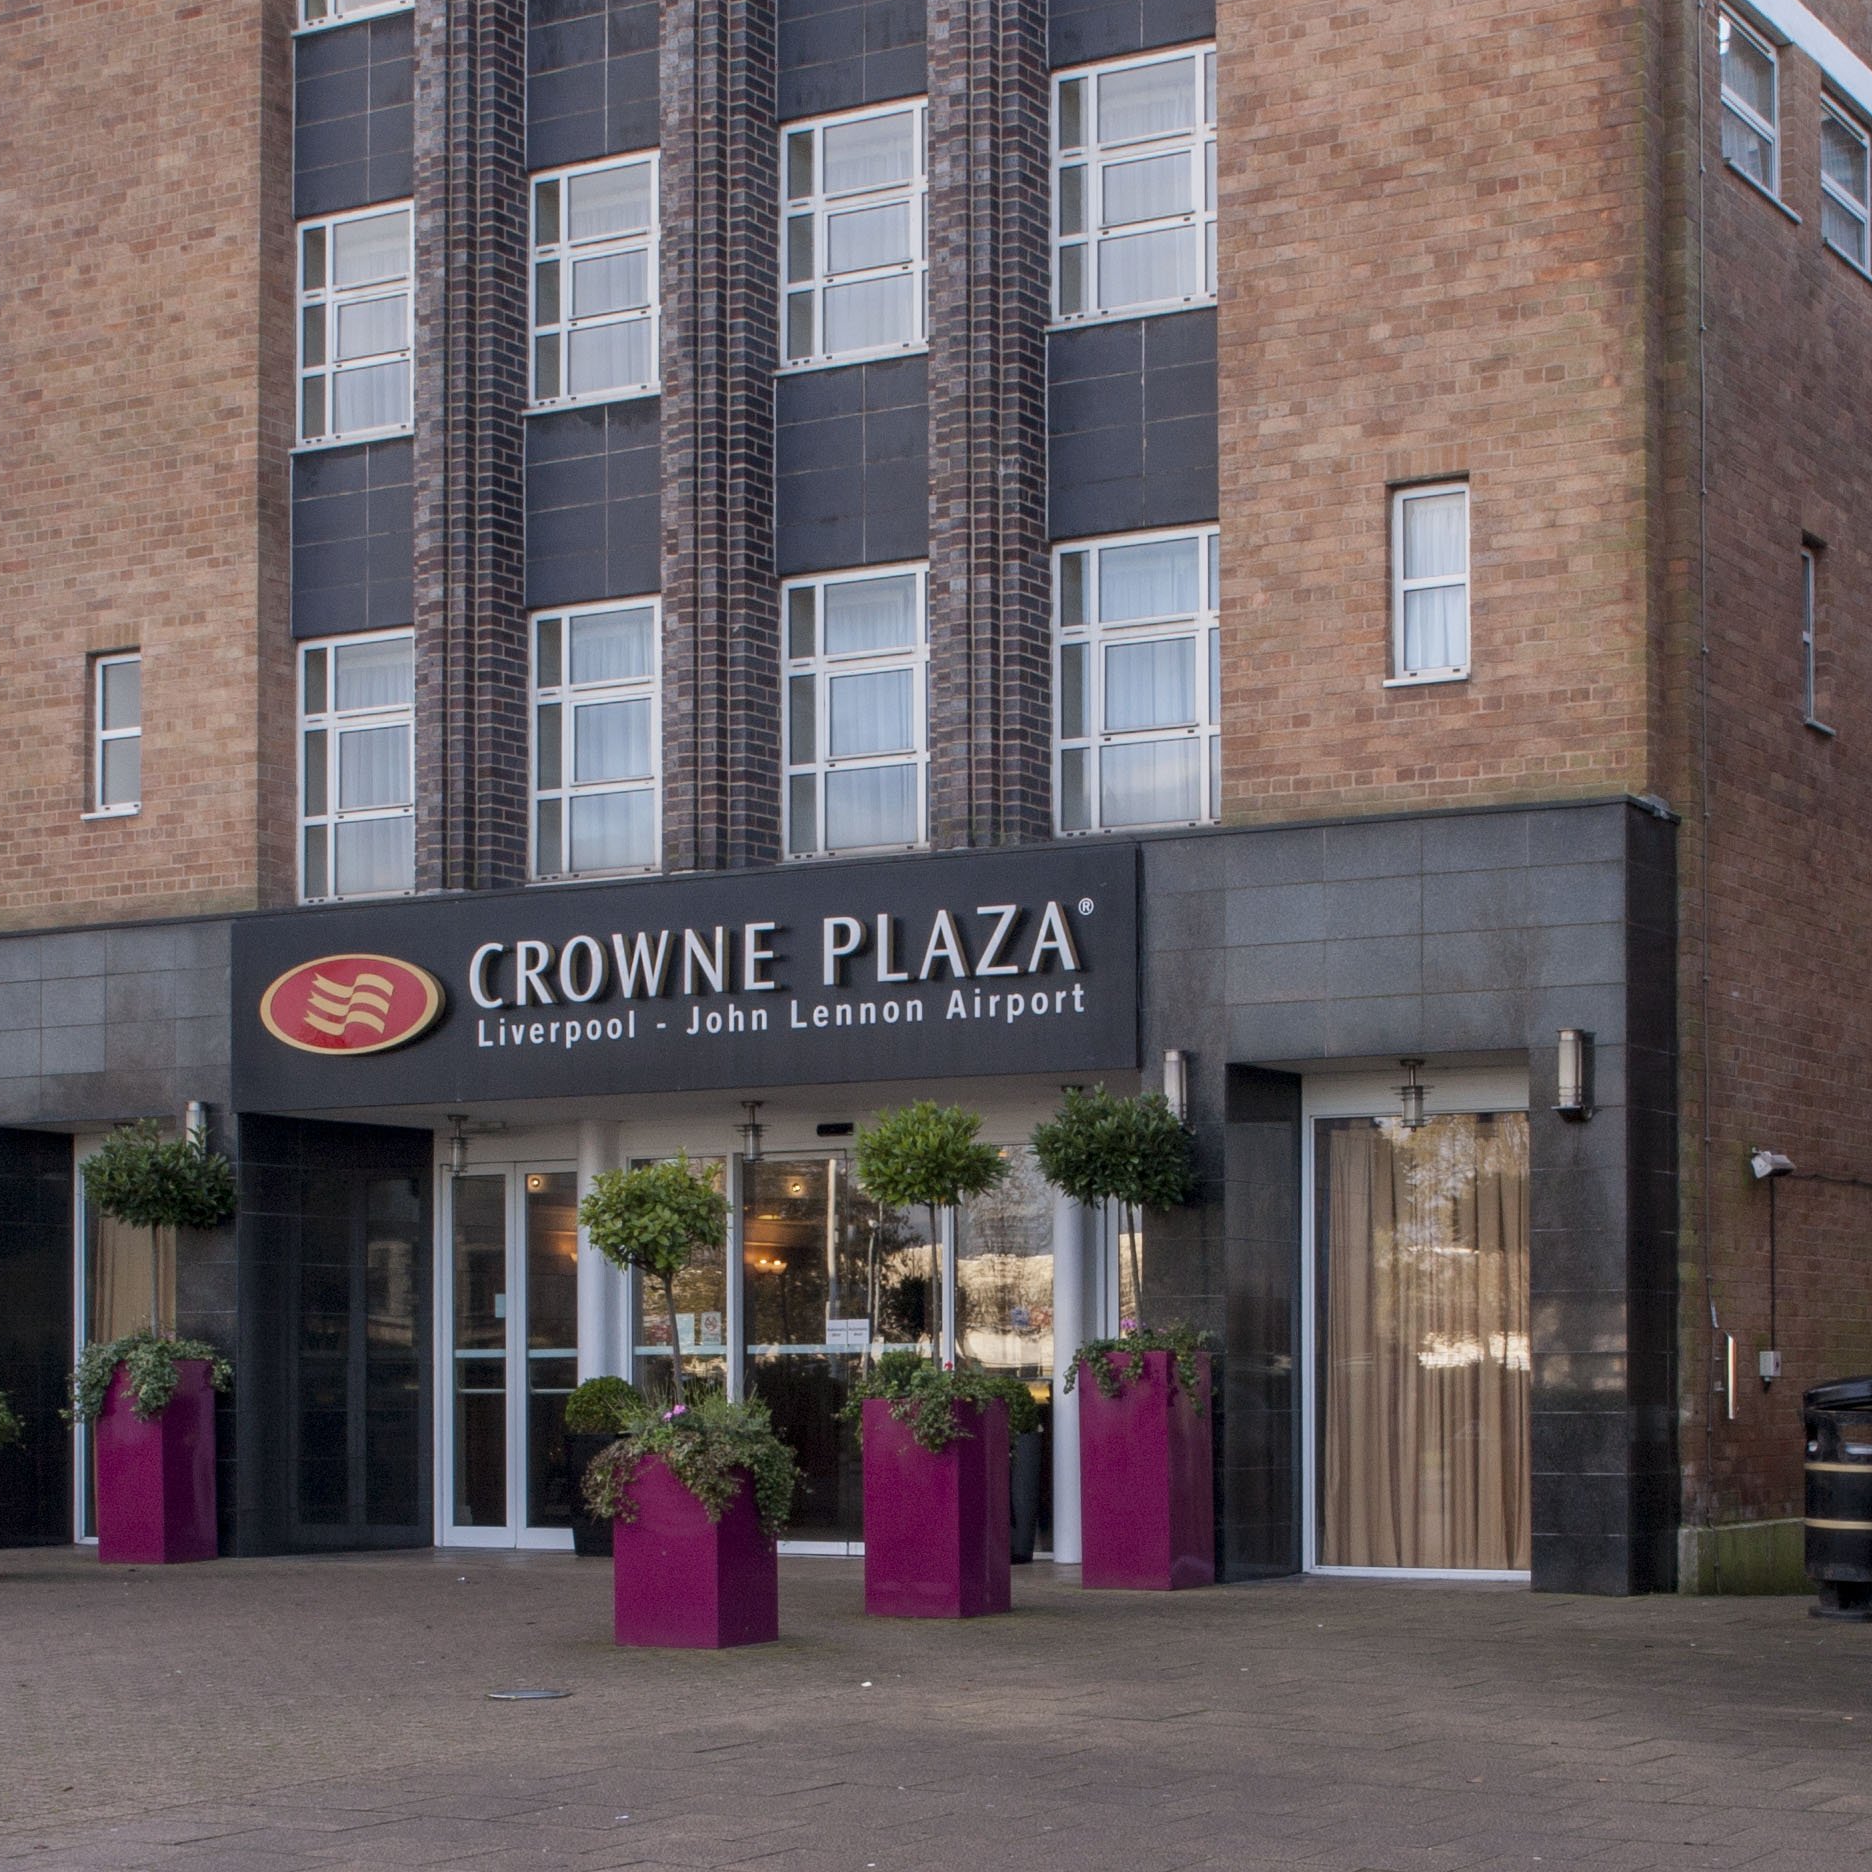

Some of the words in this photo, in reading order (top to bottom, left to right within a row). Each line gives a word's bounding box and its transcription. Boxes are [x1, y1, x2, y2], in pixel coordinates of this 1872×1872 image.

[469, 921, 776, 1009] CROWNE
[478, 1010, 635, 1049] Liverpool
[686, 1003, 768, 1035] John
[790, 998, 924, 1029] Lennon
[946, 983, 1085, 1024] Airport
